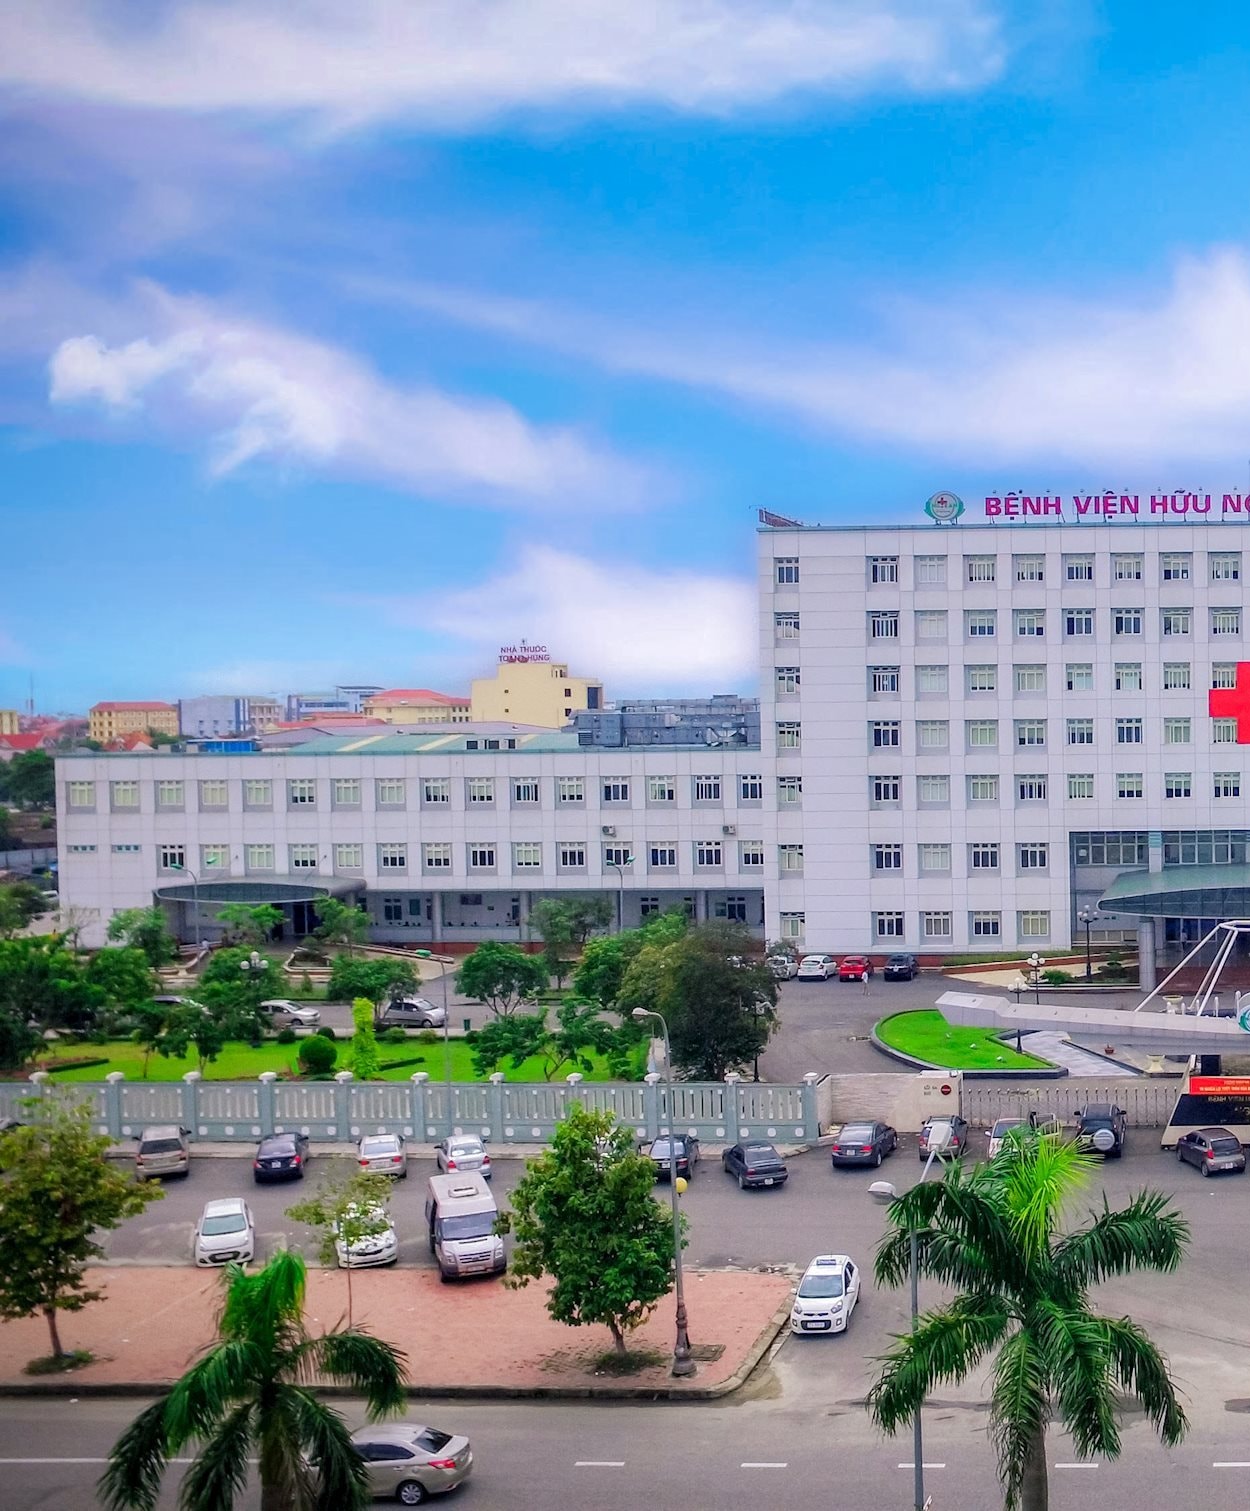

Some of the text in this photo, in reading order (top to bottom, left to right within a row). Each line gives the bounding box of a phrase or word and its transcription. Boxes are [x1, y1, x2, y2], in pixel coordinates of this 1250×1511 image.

[985, 491, 1061, 520] BỆNH
[1073, 490, 1139, 519] VIỆN
[1150, 489, 1211, 514] HỮU
